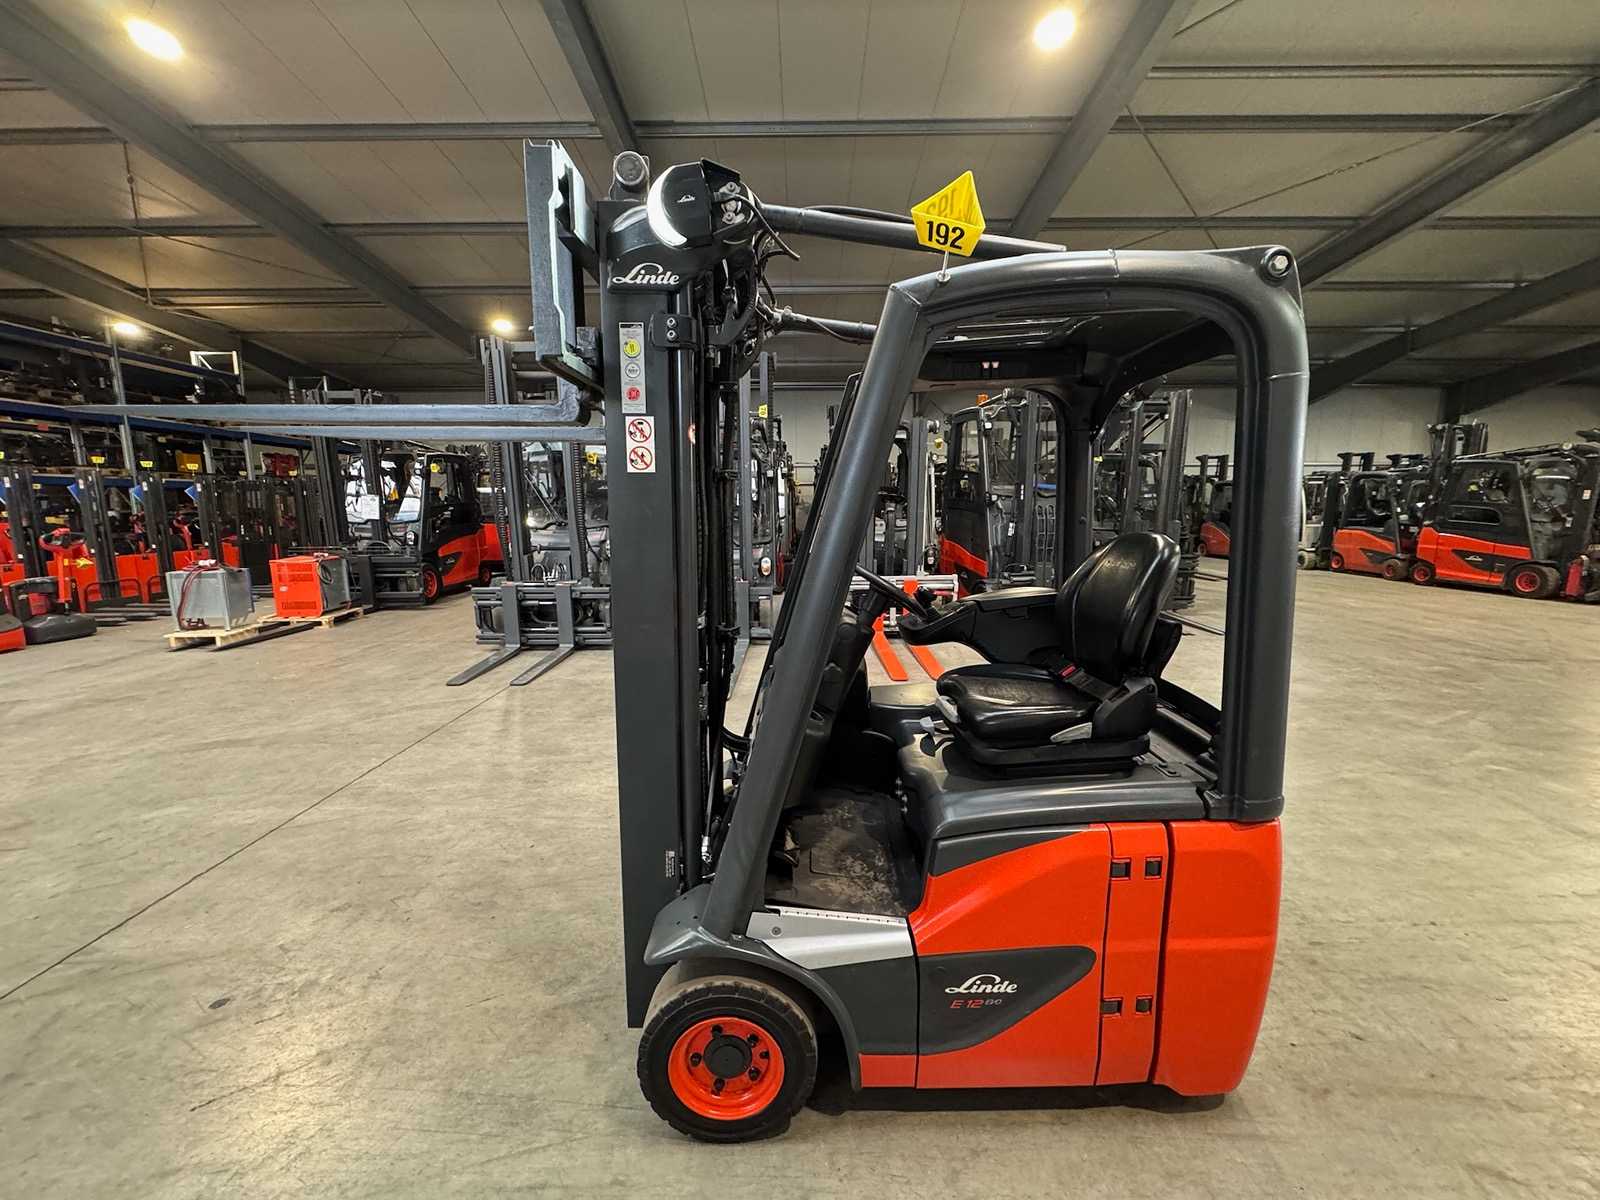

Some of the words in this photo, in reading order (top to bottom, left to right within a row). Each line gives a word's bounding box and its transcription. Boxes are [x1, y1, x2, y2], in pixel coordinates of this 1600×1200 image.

[926, 220, 966, 250] 192
[611, 262, 680, 285] Linde
[944, 974, 1018, 994] Linde
